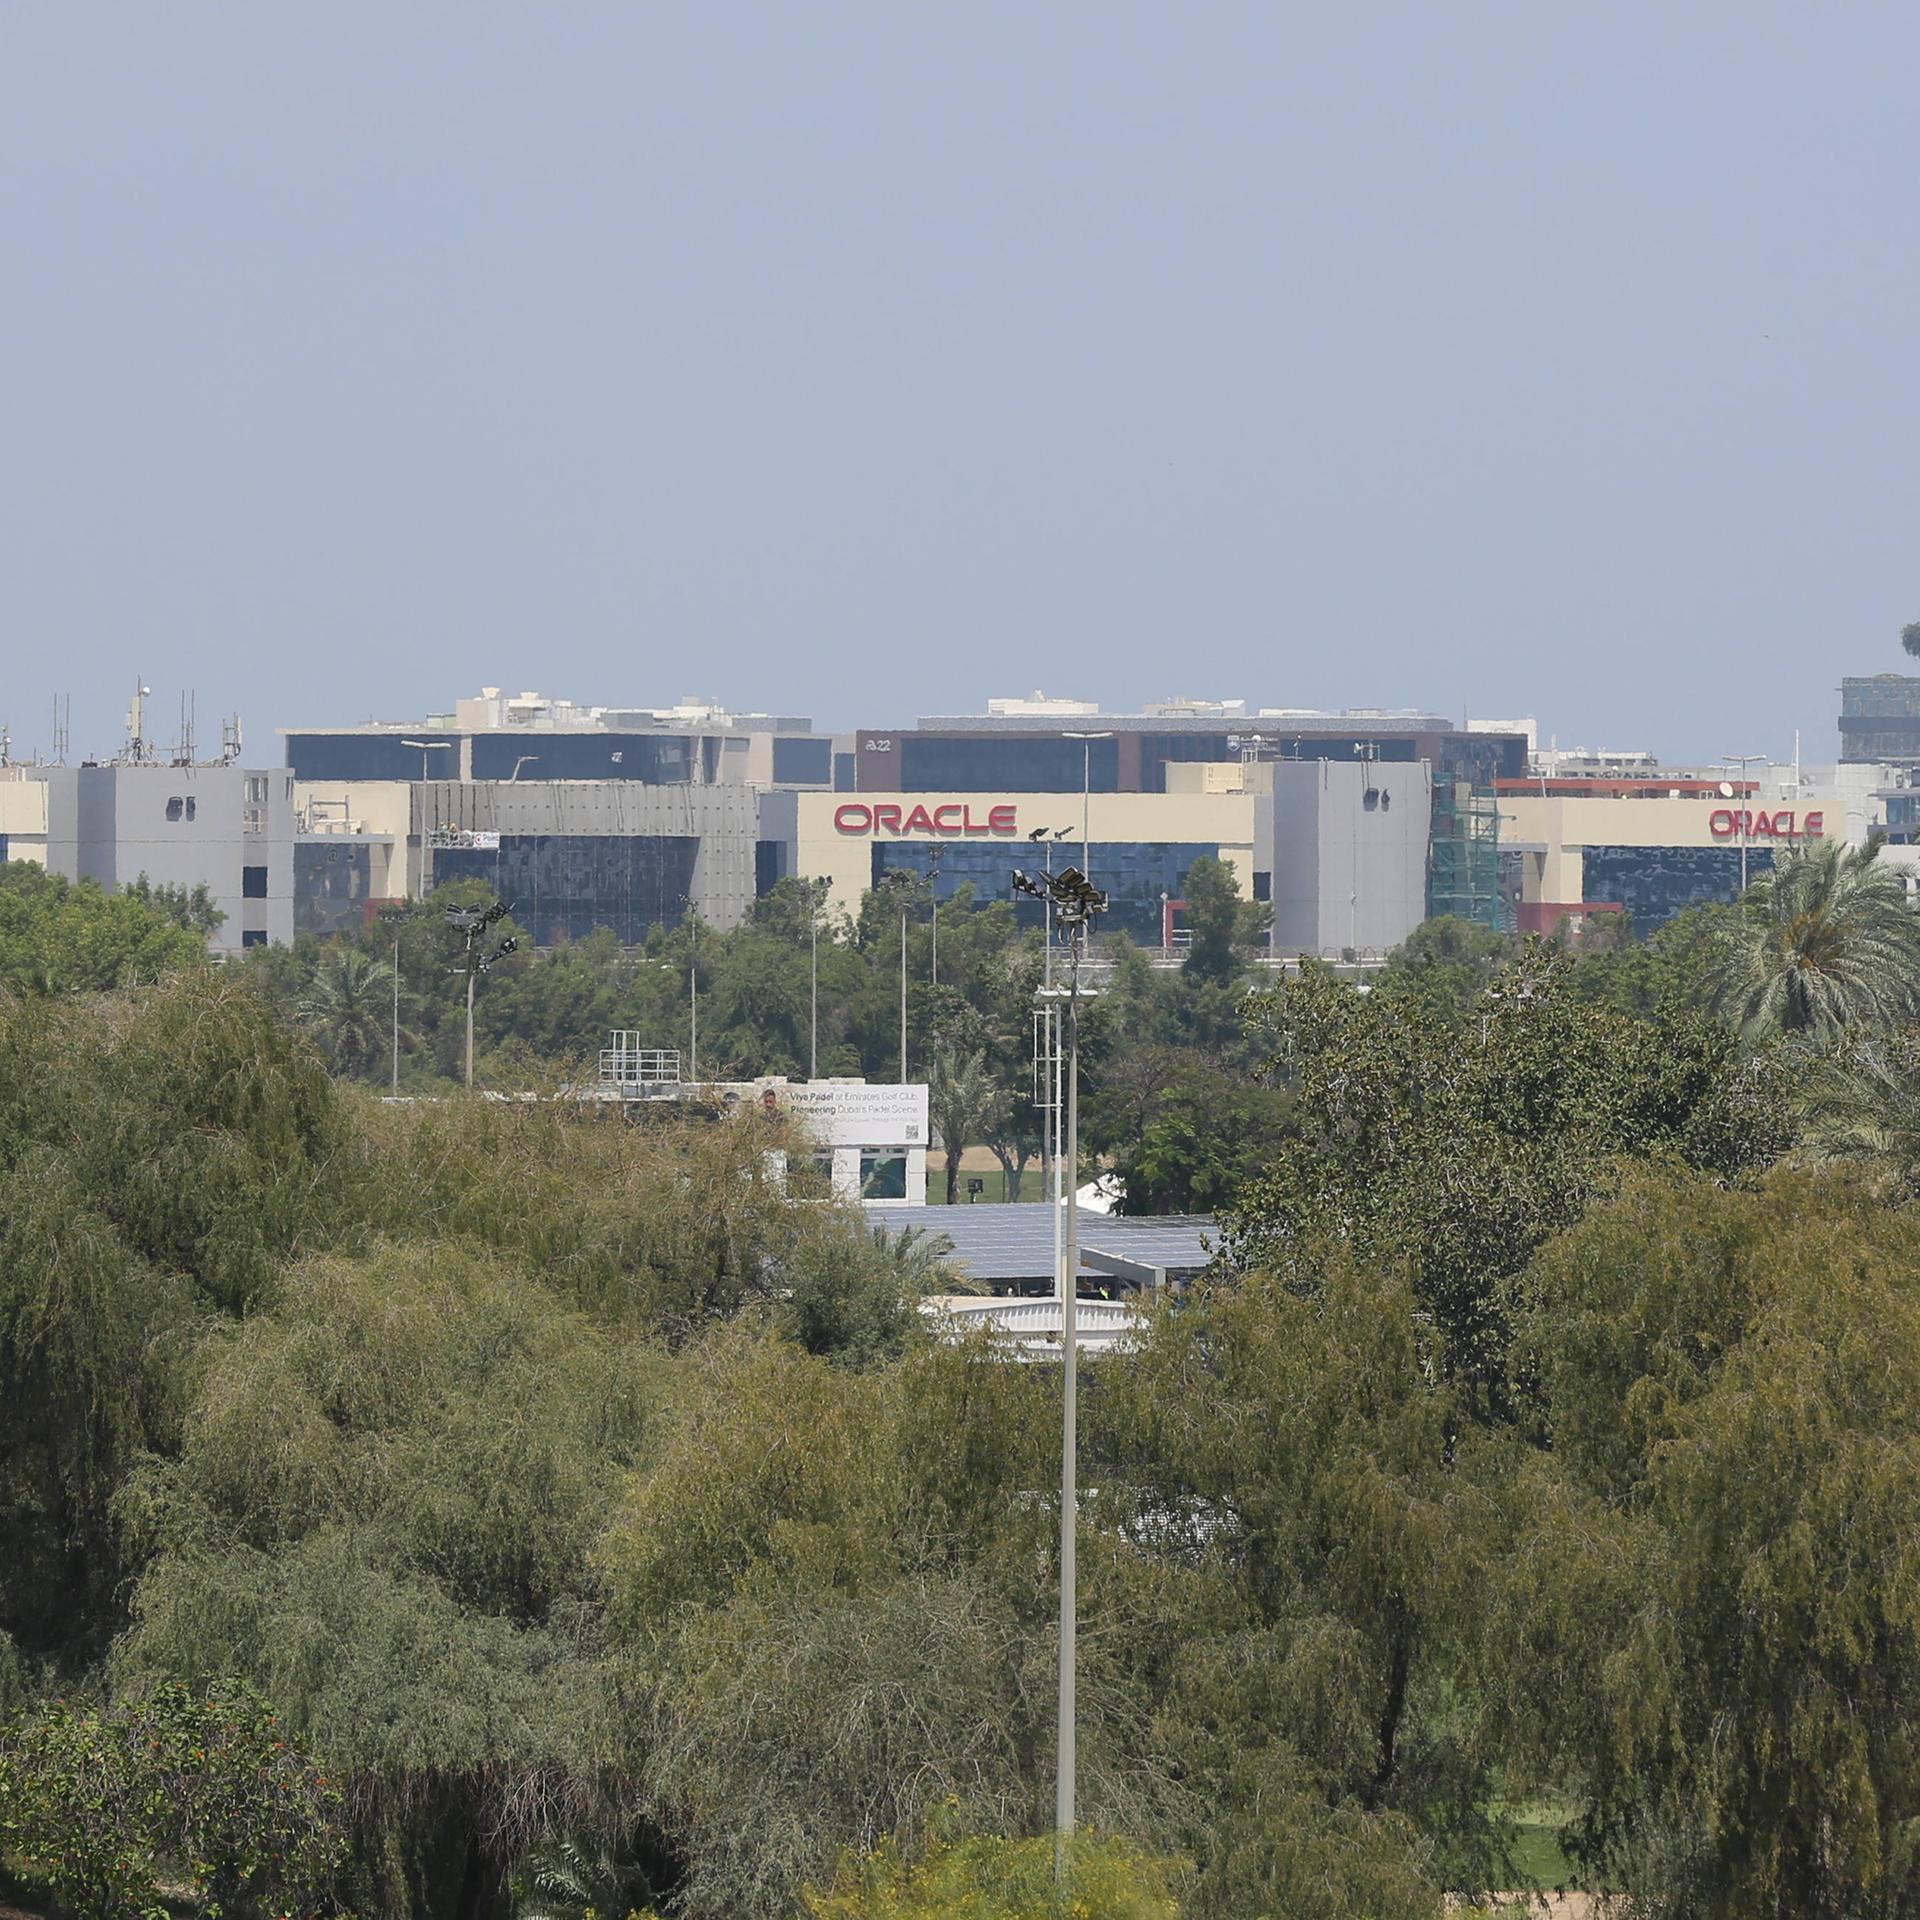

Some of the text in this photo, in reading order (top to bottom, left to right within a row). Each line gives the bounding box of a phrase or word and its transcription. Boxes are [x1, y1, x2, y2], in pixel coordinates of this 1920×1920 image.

[834, 804, 1017, 835] ORACLE
[1709, 809, 1824, 839] ORACLE
[809, 1092, 834, 1101] Padel
[845, 1092, 880, 1101] Emirates
[881, 1092, 898, 1101] Golf
[790, 1105, 837, 1115] Pioneering
[868, 1104, 891, 1114] Padel
